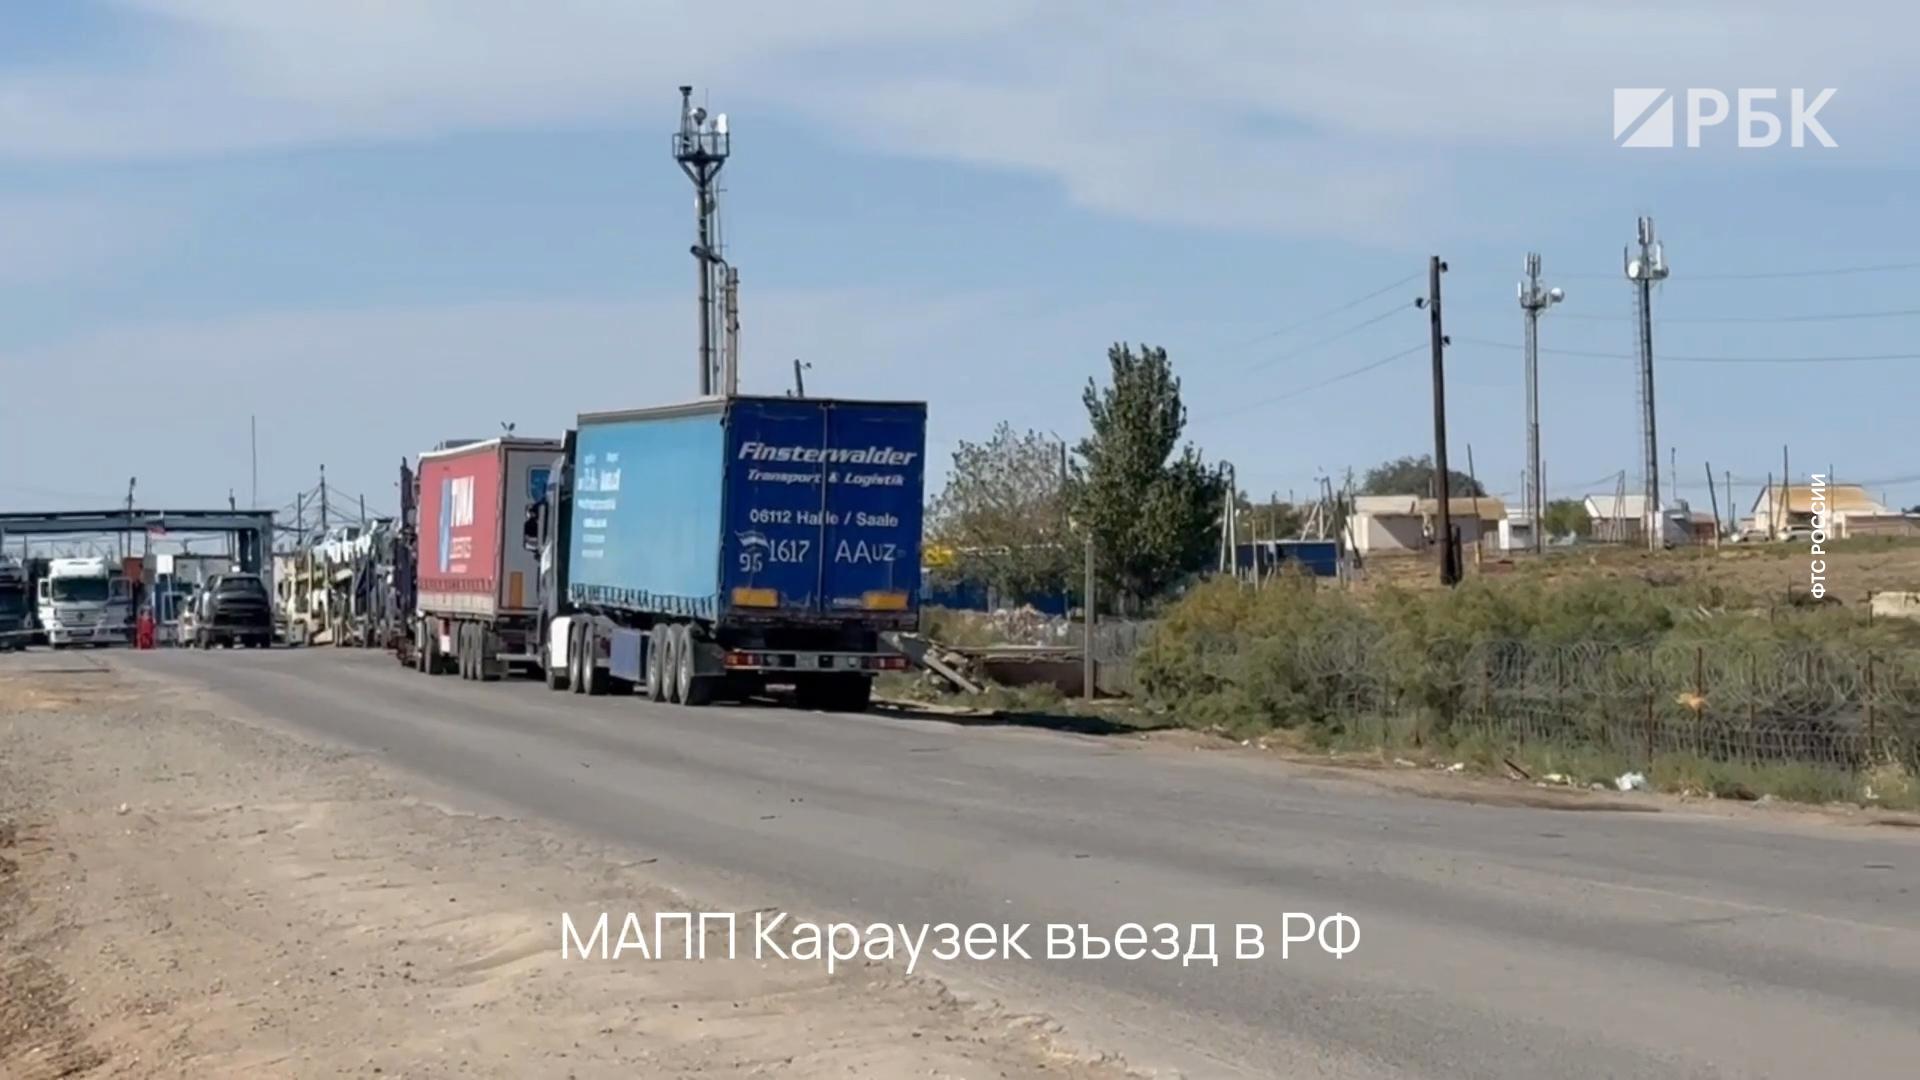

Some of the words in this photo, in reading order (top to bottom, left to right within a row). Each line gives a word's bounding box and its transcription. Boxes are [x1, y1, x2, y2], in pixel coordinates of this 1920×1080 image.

[738, 441, 918, 466] Finsterwalder
[747, 468, 821, 485] Transport
[828, 472, 838, 483] &
[844, 472, 904, 487] Logistik
[750, 509, 792, 523] 06112
[797, 510, 839, 525] Halle
[844, 510, 852, 525] /
[856, 512, 899, 527] Saale
[769, 539, 810, 563] 1617
